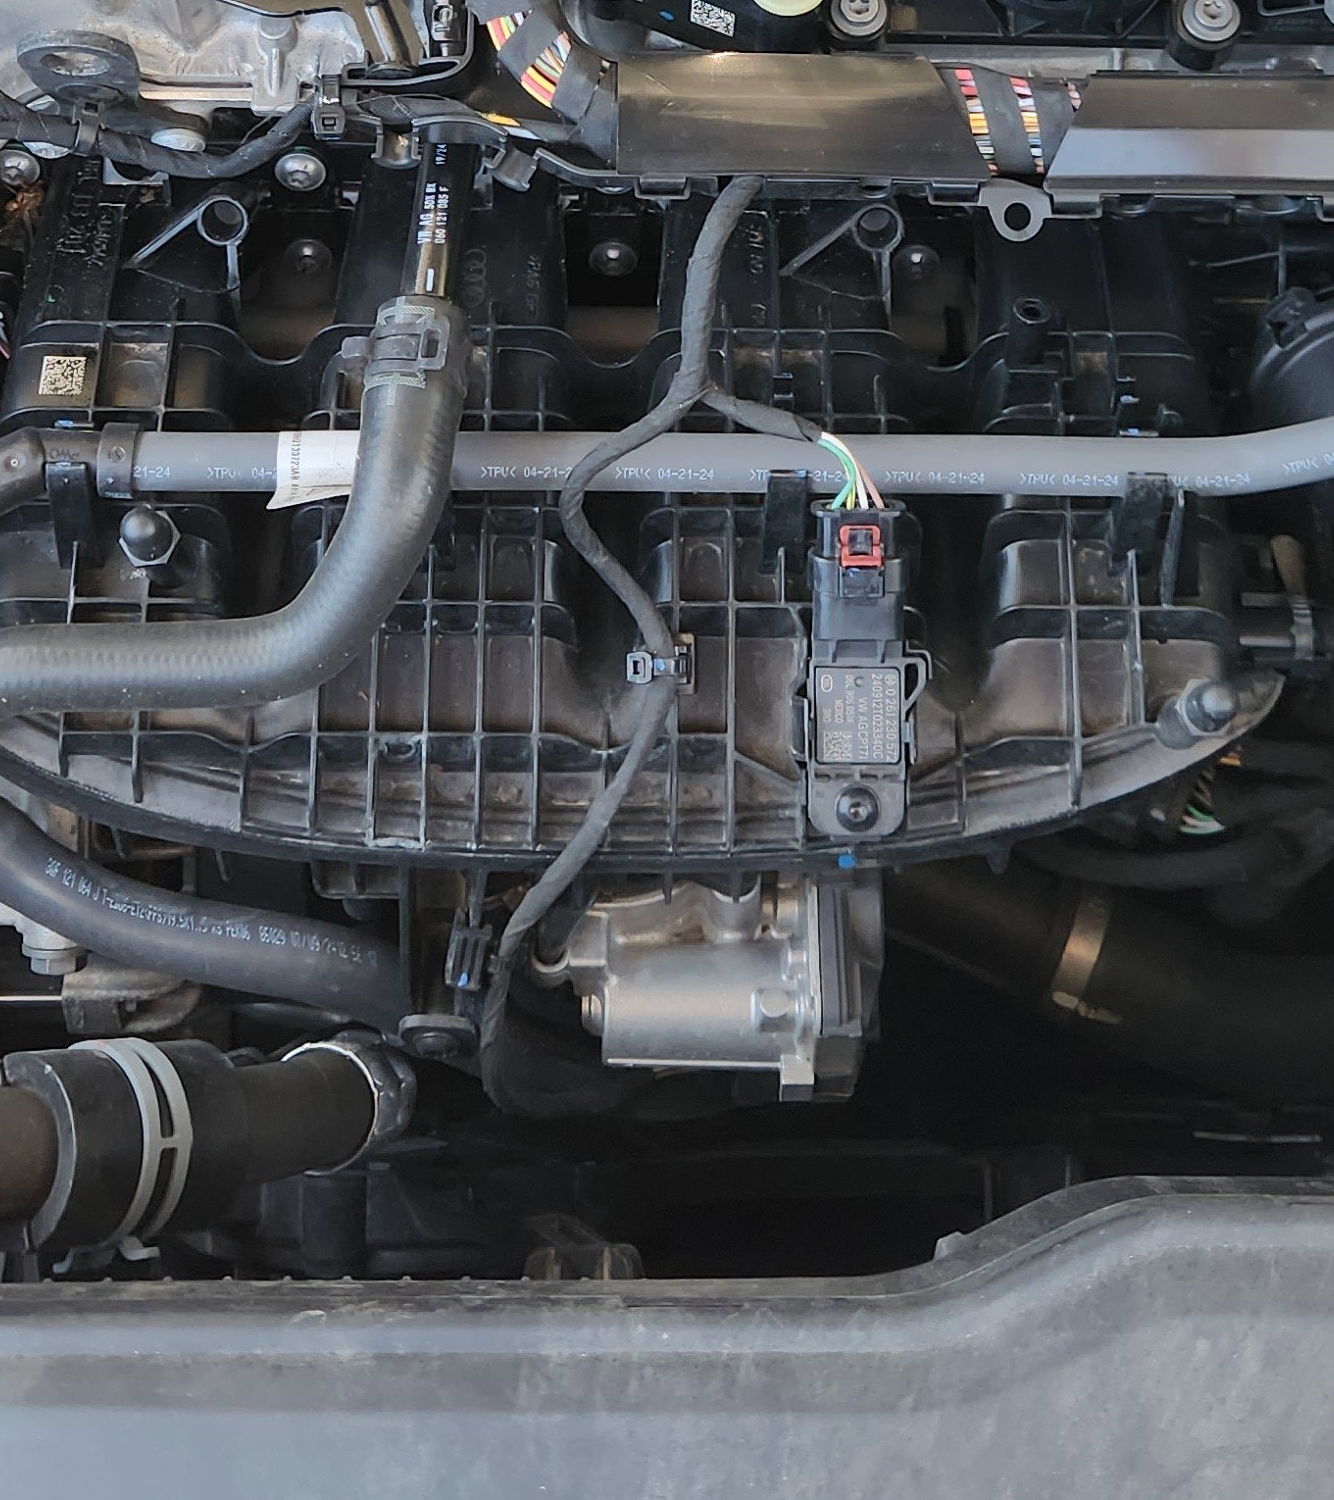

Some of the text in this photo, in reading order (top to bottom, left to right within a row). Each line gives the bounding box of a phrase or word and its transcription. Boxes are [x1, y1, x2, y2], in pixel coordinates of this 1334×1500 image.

[418, 212, 433, 226] AG
[436, 211, 447, 226] 121
[523, 465, 572, 479] 04-21-2
[858, 696, 867, 712] VW
[885, 698, 895, 716] 261
[857, 715, 867, 729] AG
[885, 719, 895, 740] 230
